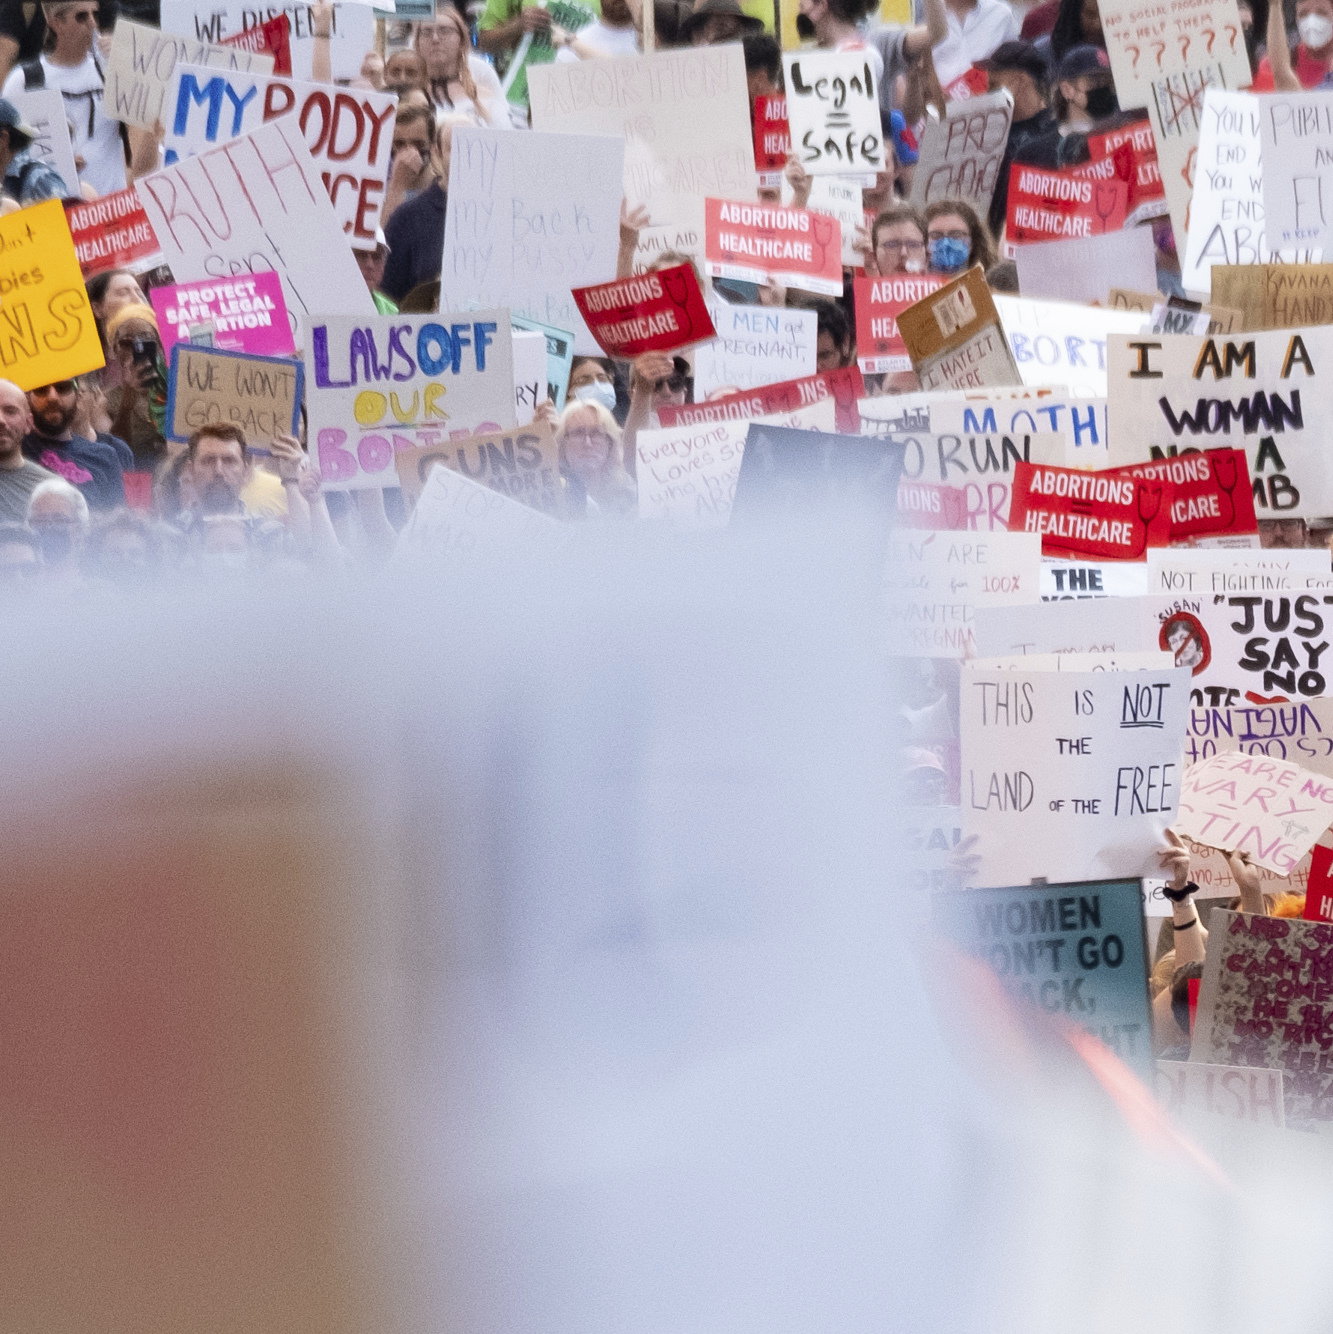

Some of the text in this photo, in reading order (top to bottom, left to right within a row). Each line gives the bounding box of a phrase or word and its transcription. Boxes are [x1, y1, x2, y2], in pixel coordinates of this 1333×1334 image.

[173, 74, 257, 142] MY
[144, 117, 320, 254] RUTH
[1018, 170, 1092, 202] ABORTIONS
[720, 204, 810, 232] ABORTIONS
[1015, 206, 1092, 236] HEALTHCARE
[719, 234, 813, 262] HEALTHCARE
[177, 281, 256, 305] PROTECT
[220, 294, 276, 316] LEGAL
[584, 275, 663, 313] ABORTIONS
[1194, 335, 1315, 379] AM A
[354, 383, 450, 424] OUR
[1160, 390, 1304, 434] WOMAN
[1030, 471, 1134, 505] ABORTIONS
[1024, 511, 1133, 545] HEALTHCARE
[1239, 638, 1330, 671] SAY
[1263, 671, 1325, 696] NO
[973, 683, 1170, 726] THIS IS NOT
[1056, 738, 1092, 755] THE
[970, 765, 1175, 816] LAND OF THE FREE
